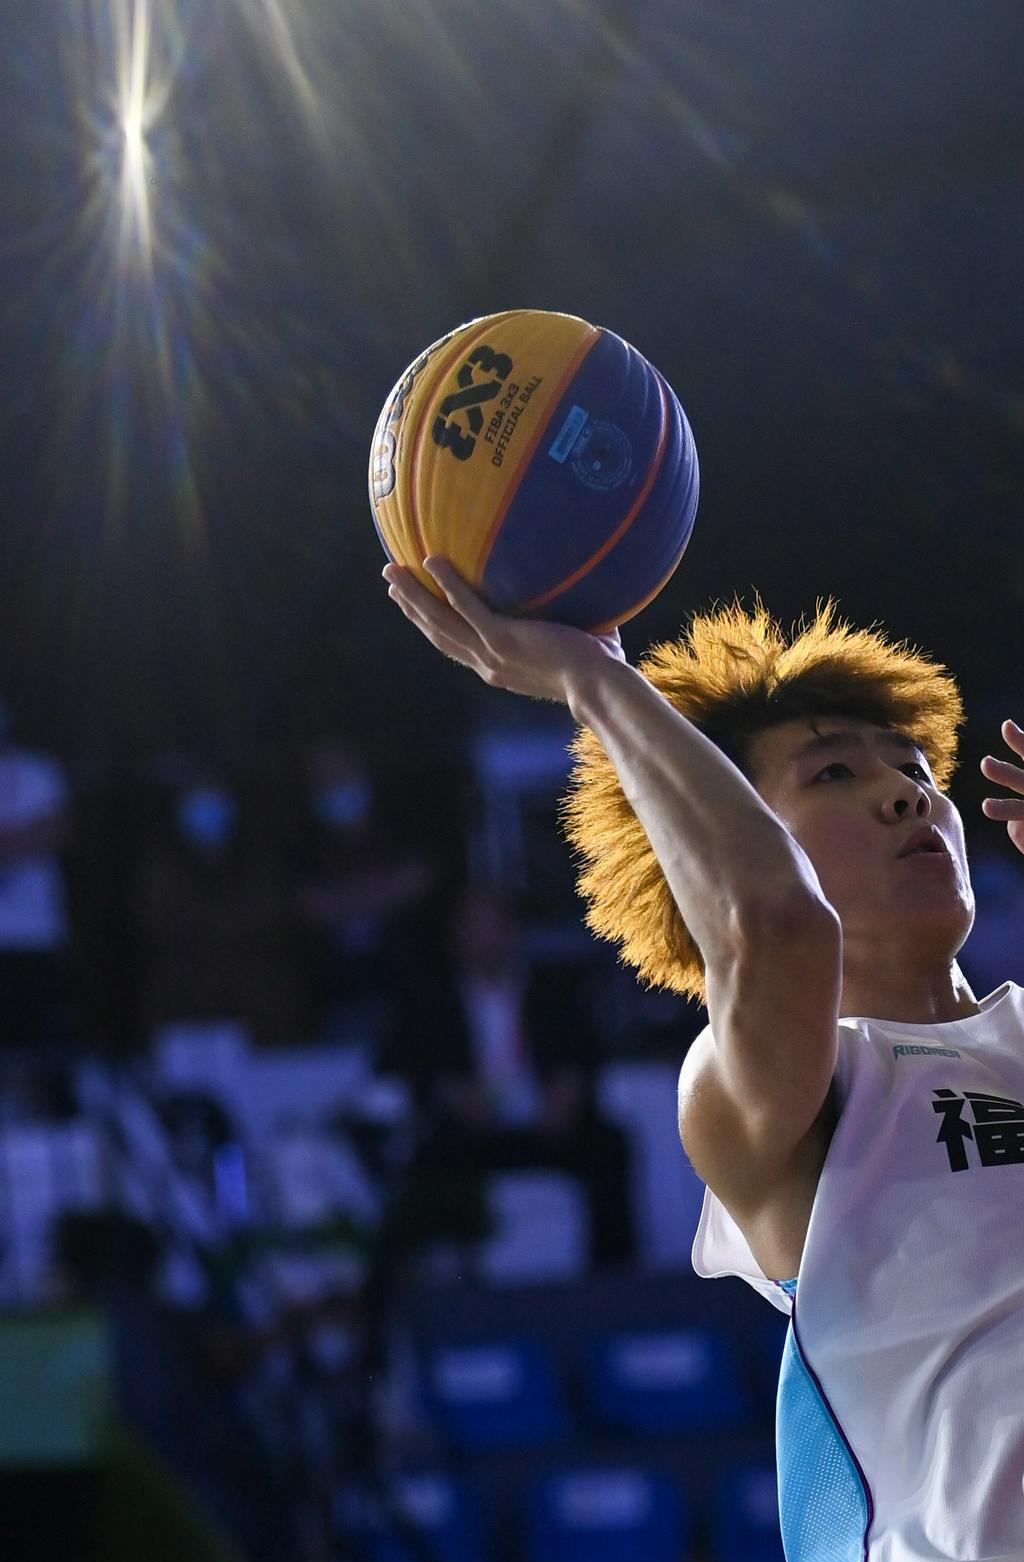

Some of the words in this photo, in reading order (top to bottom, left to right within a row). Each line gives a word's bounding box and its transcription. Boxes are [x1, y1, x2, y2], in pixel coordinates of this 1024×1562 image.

[484, 411, 506, 444] FIBA
[491, 406, 525, 467] OFFICIAL
[519, 376, 543, 403] BALL
